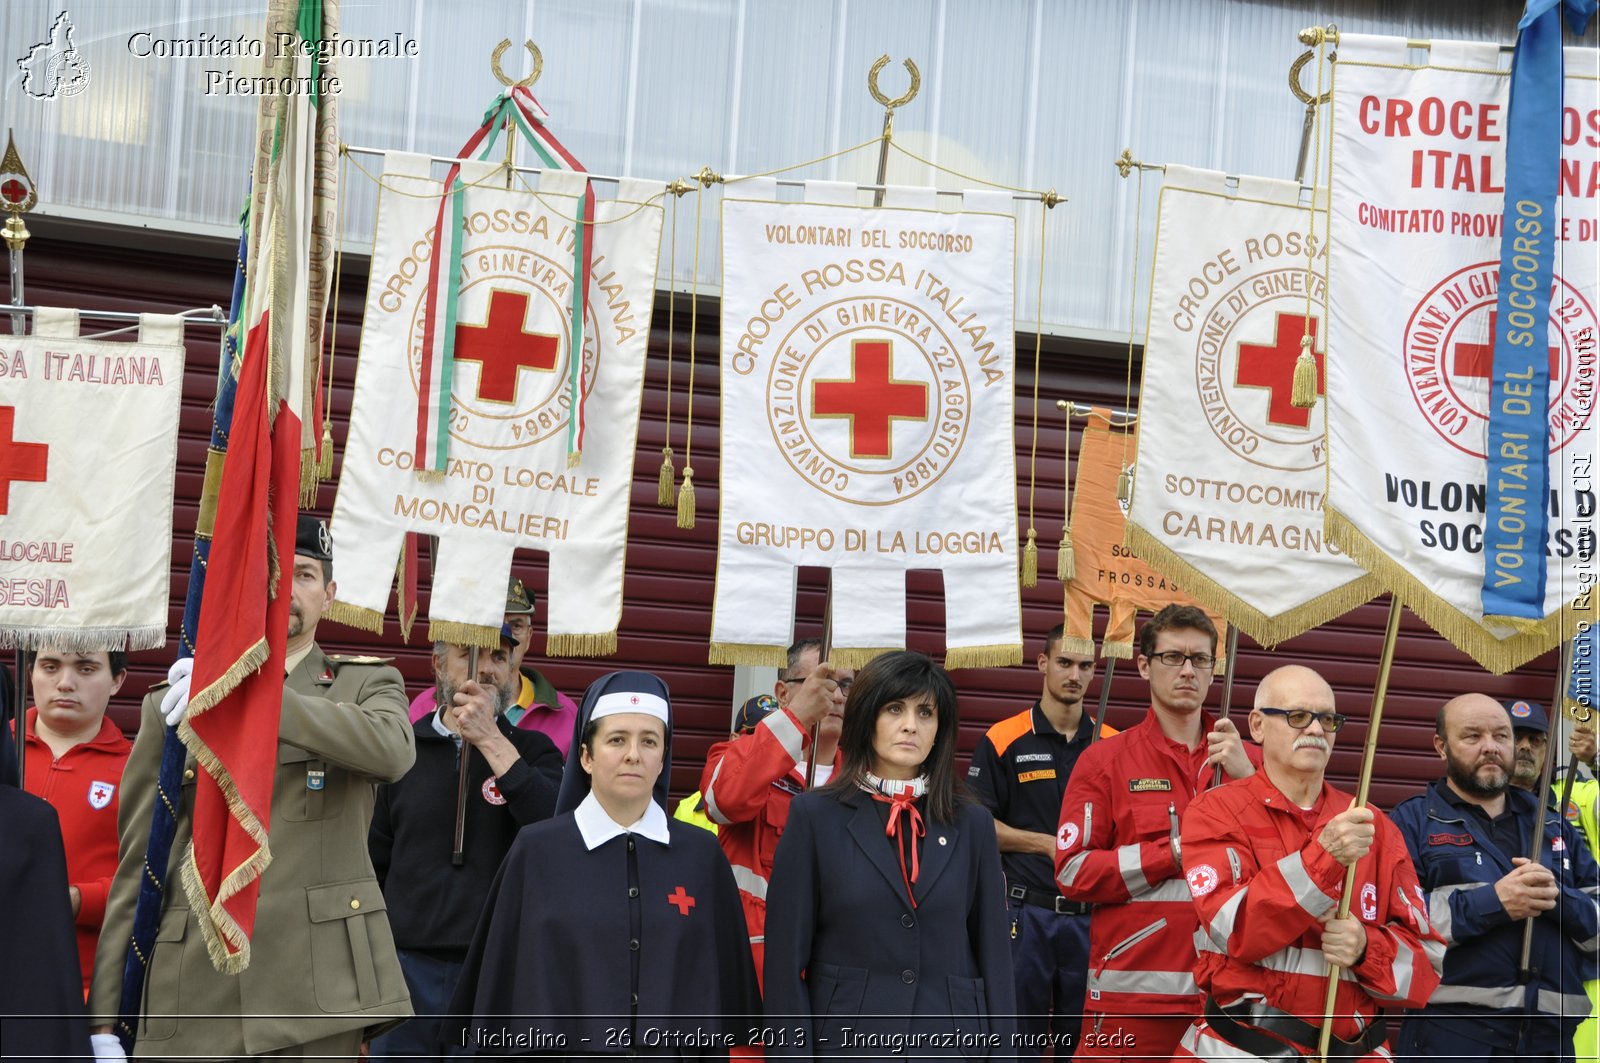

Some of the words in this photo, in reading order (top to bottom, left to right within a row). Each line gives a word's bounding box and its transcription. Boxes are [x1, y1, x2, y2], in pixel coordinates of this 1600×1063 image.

[1359, 95, 1501, 142] CROCE
[1562, 107, 1600, 148] OS
[1411, 150, 1600, 198] ITALN
[765, 224, 851, 248] VOLONTARI
[861, 229, 891, 249] DEL
[899, 230, 973, 253] SOCCORSO
[1359, 202, 1444, 234] COMITATO
[478, 253, 568, 298] GINEVRA
[556, 226, 636, 345] ILIANA
[1173, 248, 1241, 332] CROCE
[1253, 273, 1326, 299] GINEVR
[1506, 200, 1543, 347] SOCCORSO
[732, 283, 802, 376] CROCE
[800, 258, 906, 295] ROSSA
[914, 268, 1005, 387] ITALIANA
[836, 302, 932, 343] GINEVRA
[1227, 289, 1249, 315] DI
[804, 318, 829, 343] DI
[44, 351, 164, 386] ITALIANA
[932, 346, 956, 372] 22
[1410, 305, 1468, 436] CONVENZIONE
[1442, 283, 1469, 312] DI
[1555, 298, 1583, 324] 22
[1200, 311, 1259, 455] CONVENZIONE
[1502, 366, 1534, 415] DEL
[511, 407, 561, 440] 1864
[774, 346, 848, 491] CONVENZIONE
[933, 379, 964, 458] AGOSTO
[377, 447, 493, 482] COATO
[504, 466, 600, 497] LOCALE
[893, 456, 938, 494] 1864
[394, 495, 569, 540] MONCALIERI
[473, 485, 495, 505] DI
[1386, 473, 1559, 518] VOLONI
[1494, 432, 1529, 588] VOLONTARI
[0, 540, 74, 563] LOCALE
[736, 521, 835, 552] GRUPPO
[845, 528, 867, 552] DI
[877, 530, 906, 553] LA
[915, 531, 1003, 554] LOGGIA
[1420, 520, 1597, 558] SOCSO
